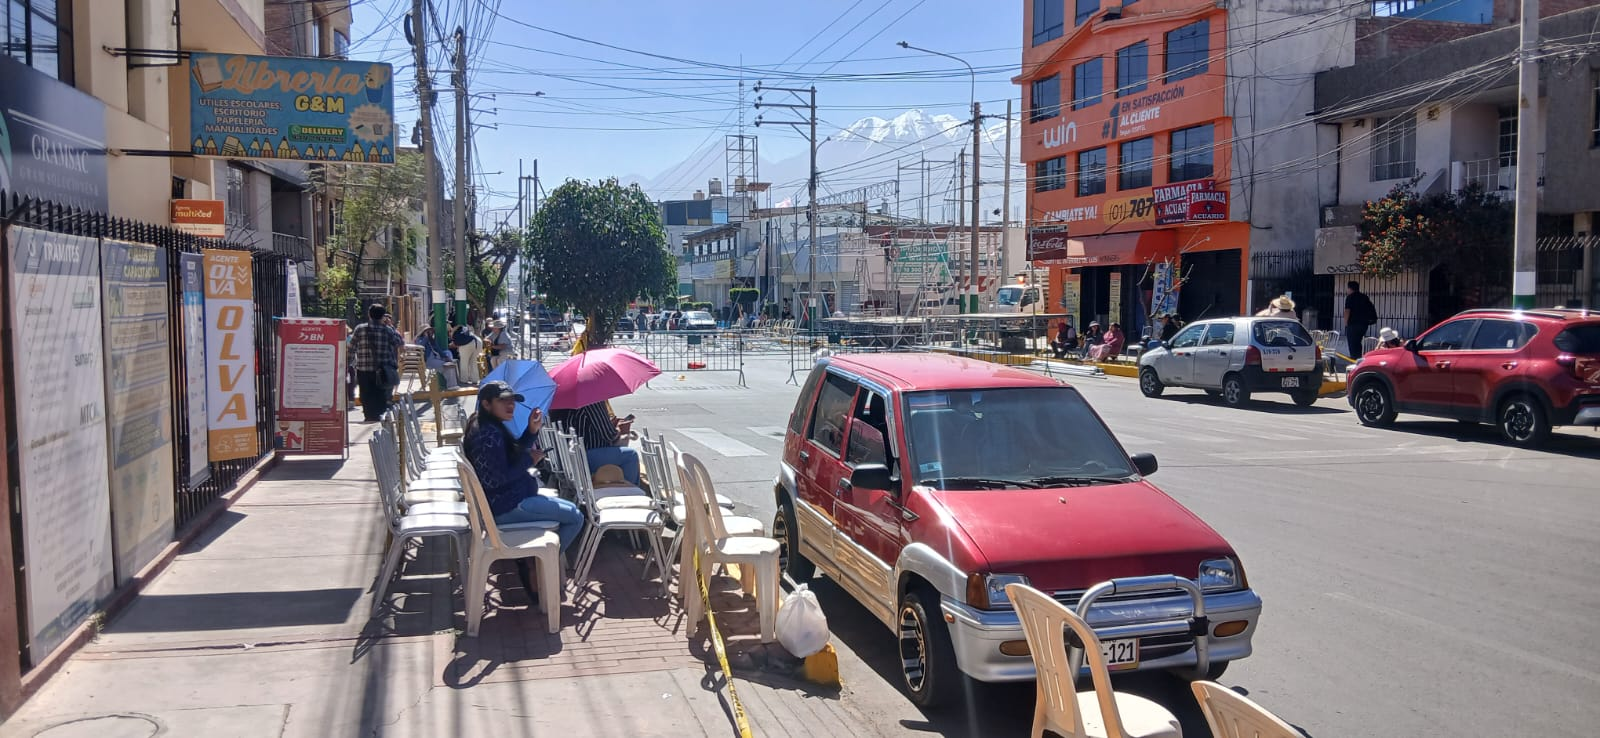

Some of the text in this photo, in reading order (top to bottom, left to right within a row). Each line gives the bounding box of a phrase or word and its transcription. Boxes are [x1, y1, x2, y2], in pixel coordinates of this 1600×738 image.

[199, 98, 228, 107] UTILES
[295, 95, 345, 114] G&M
[1121, 101, 1131, 112] EN
[1120, 106, 1160, 127] AL CLIENTE
[205, 125, 278, 135] MANUALIDADES
[301, 127, 344, 136] DELIVERY
[1043, 117, 1077, 148] win
[32, 134, 88, 174] GRAMSAC
[1154, 183, 1203, 203] FARMACIA
[1191, 192, 1226, 204] FARMACIA
[1084, 204, 1098, 219] YA!
[1110, 202, 1127, 221] (01)
[1164, 202, 1187, 215] ACUAR
[210, 255, 239, 263] AGENTE
[309, 333, 325, 341] BN
